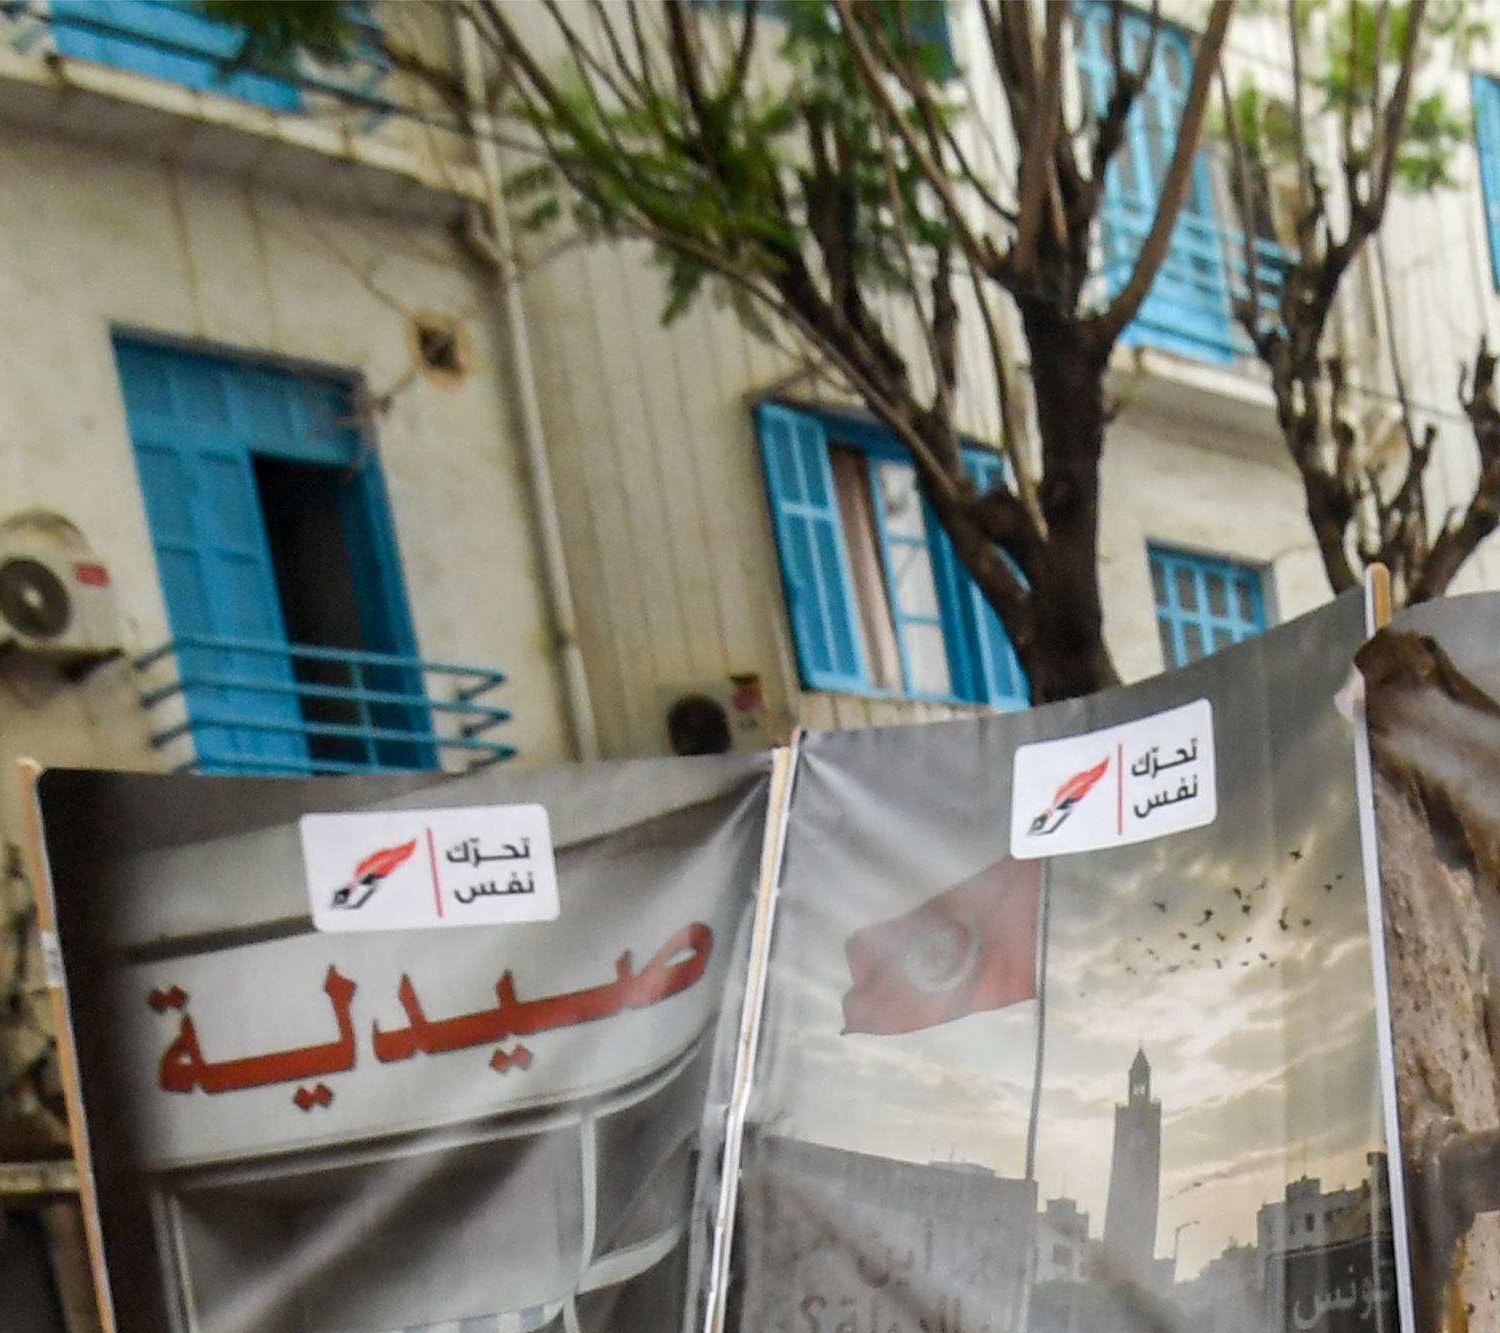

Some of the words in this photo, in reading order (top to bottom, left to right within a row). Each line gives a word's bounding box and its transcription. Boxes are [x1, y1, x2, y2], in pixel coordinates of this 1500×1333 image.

[1133, 774, 1199, 819] نفس
[453, 871, 536, 905] نفس
[149, 921, 713, 1113] صيدلية
